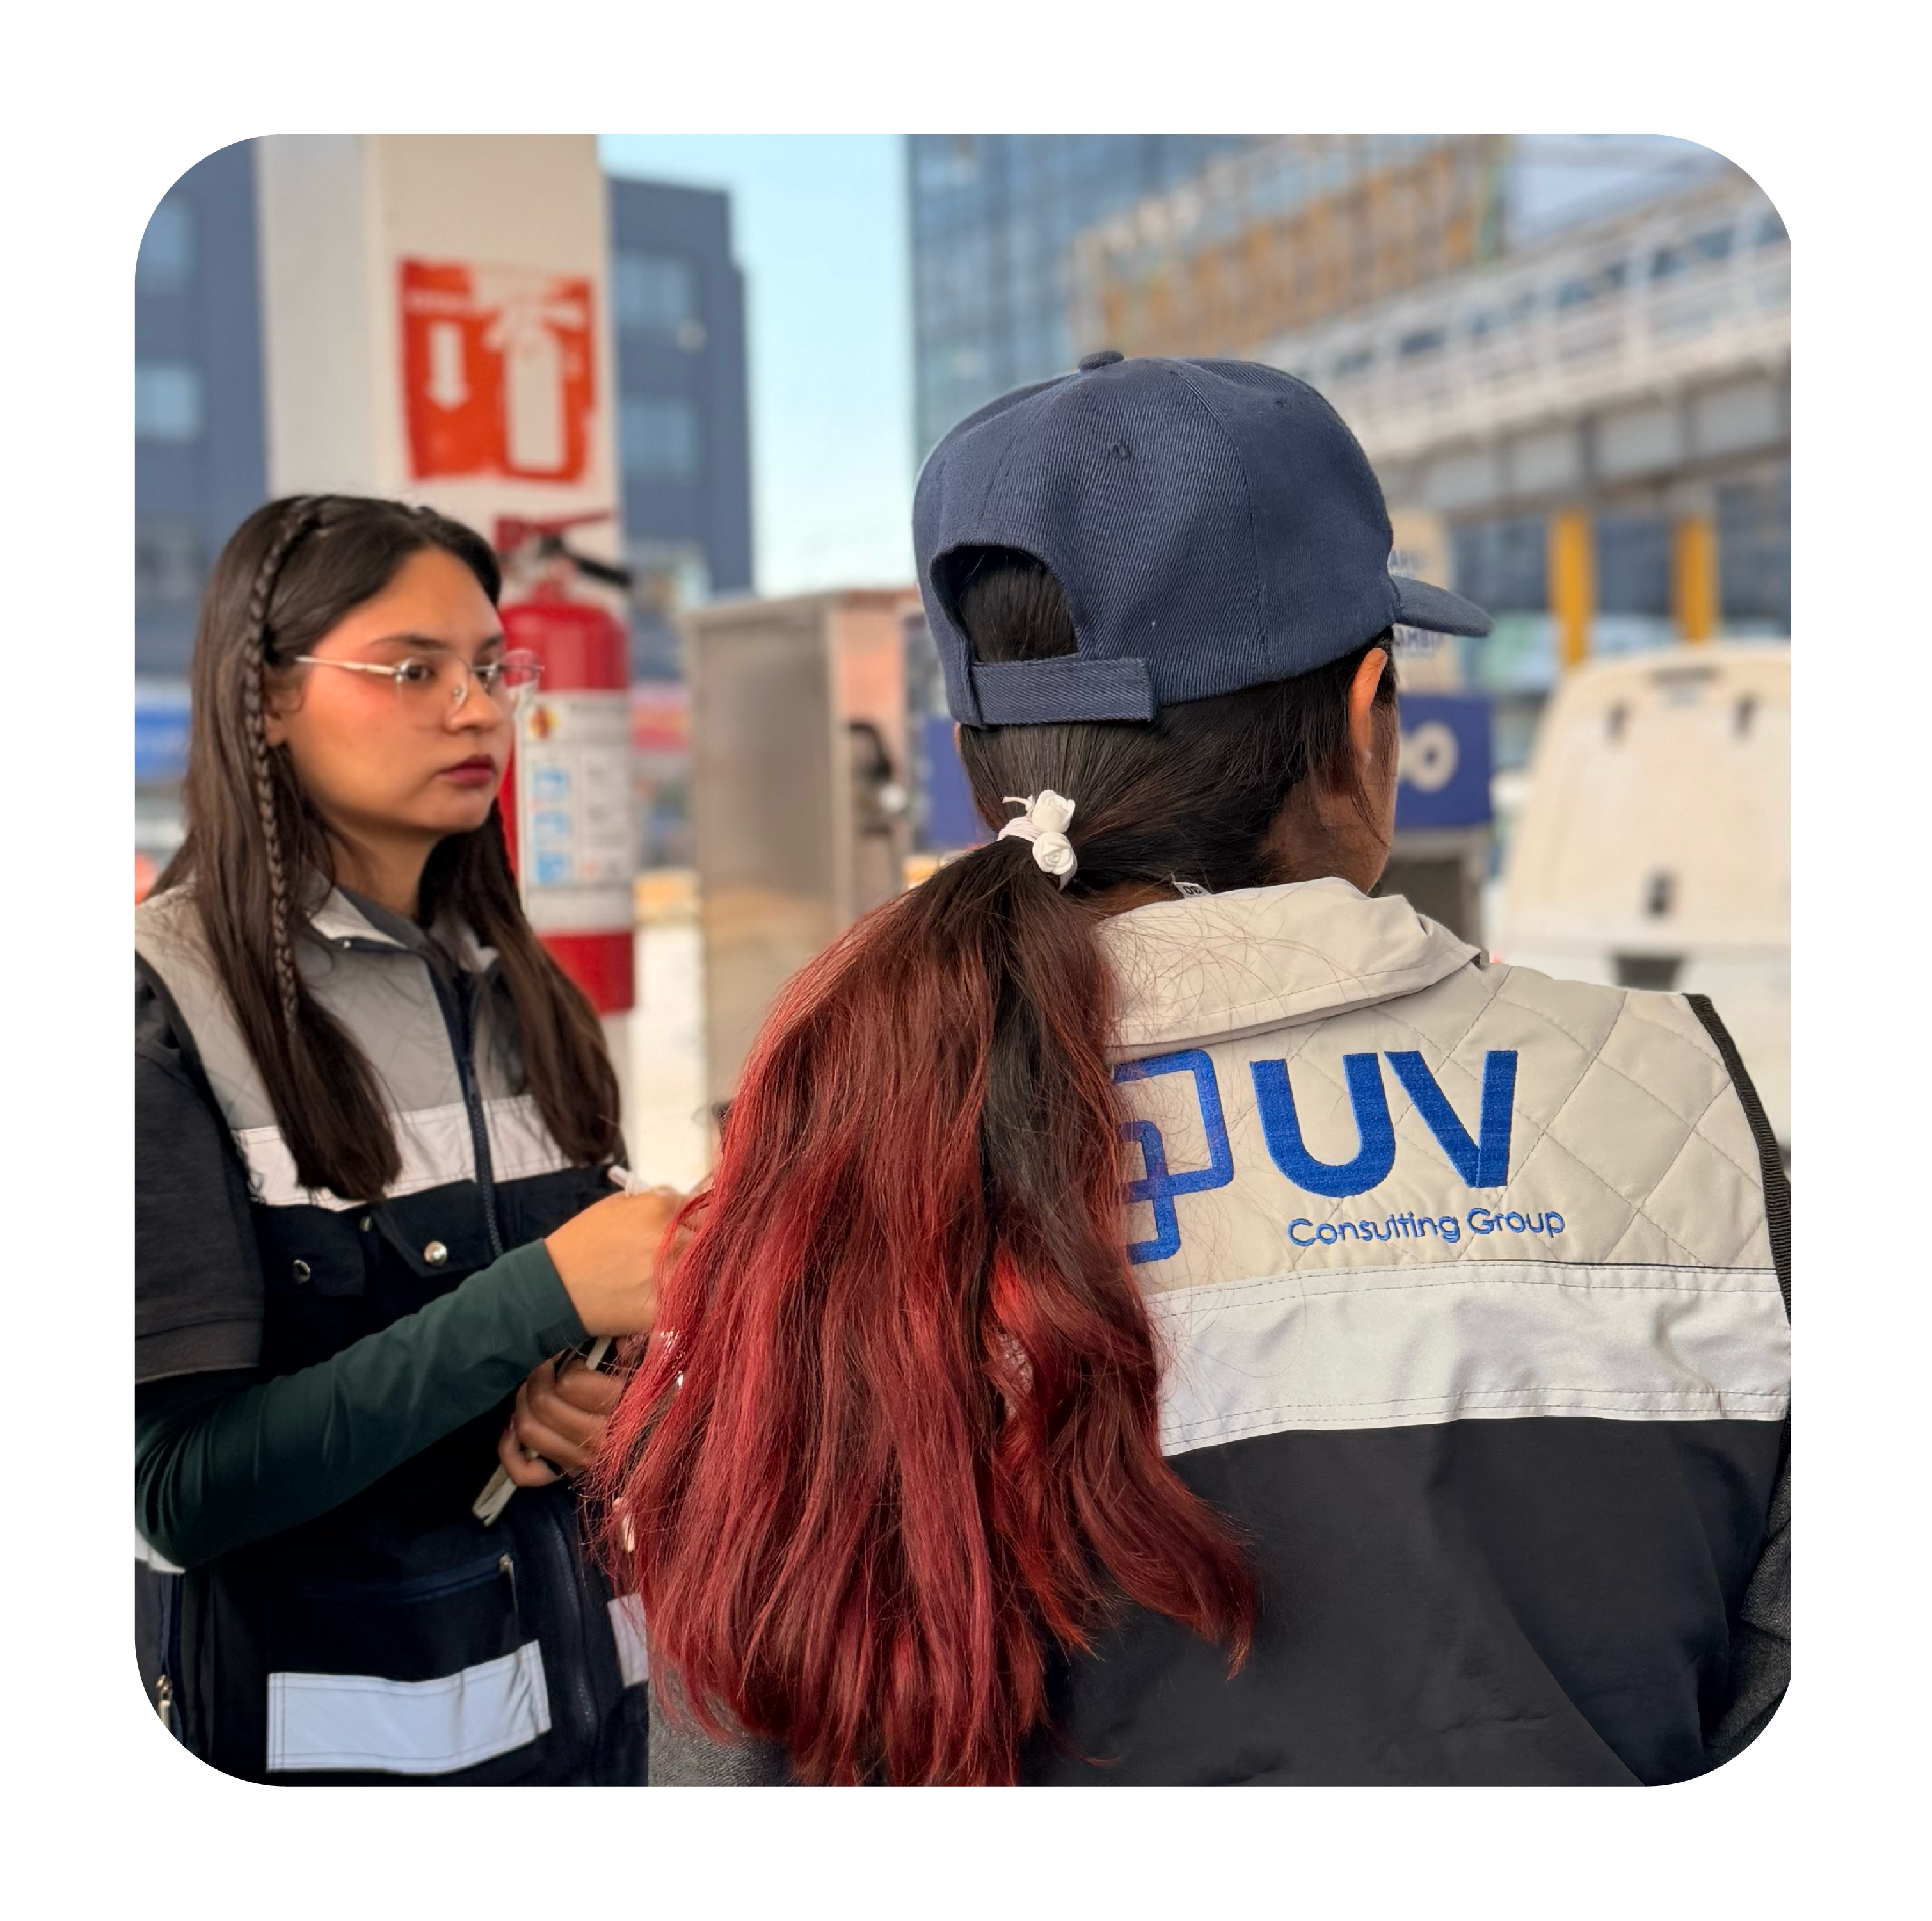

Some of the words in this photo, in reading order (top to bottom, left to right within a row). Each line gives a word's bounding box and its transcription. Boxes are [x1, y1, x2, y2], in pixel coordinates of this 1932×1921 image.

[1249, 1050, 1518, 1198] UV
[1288, 1211, 1461, 1247] Consulting
[1466, 1207, 1565, 1238] Group
